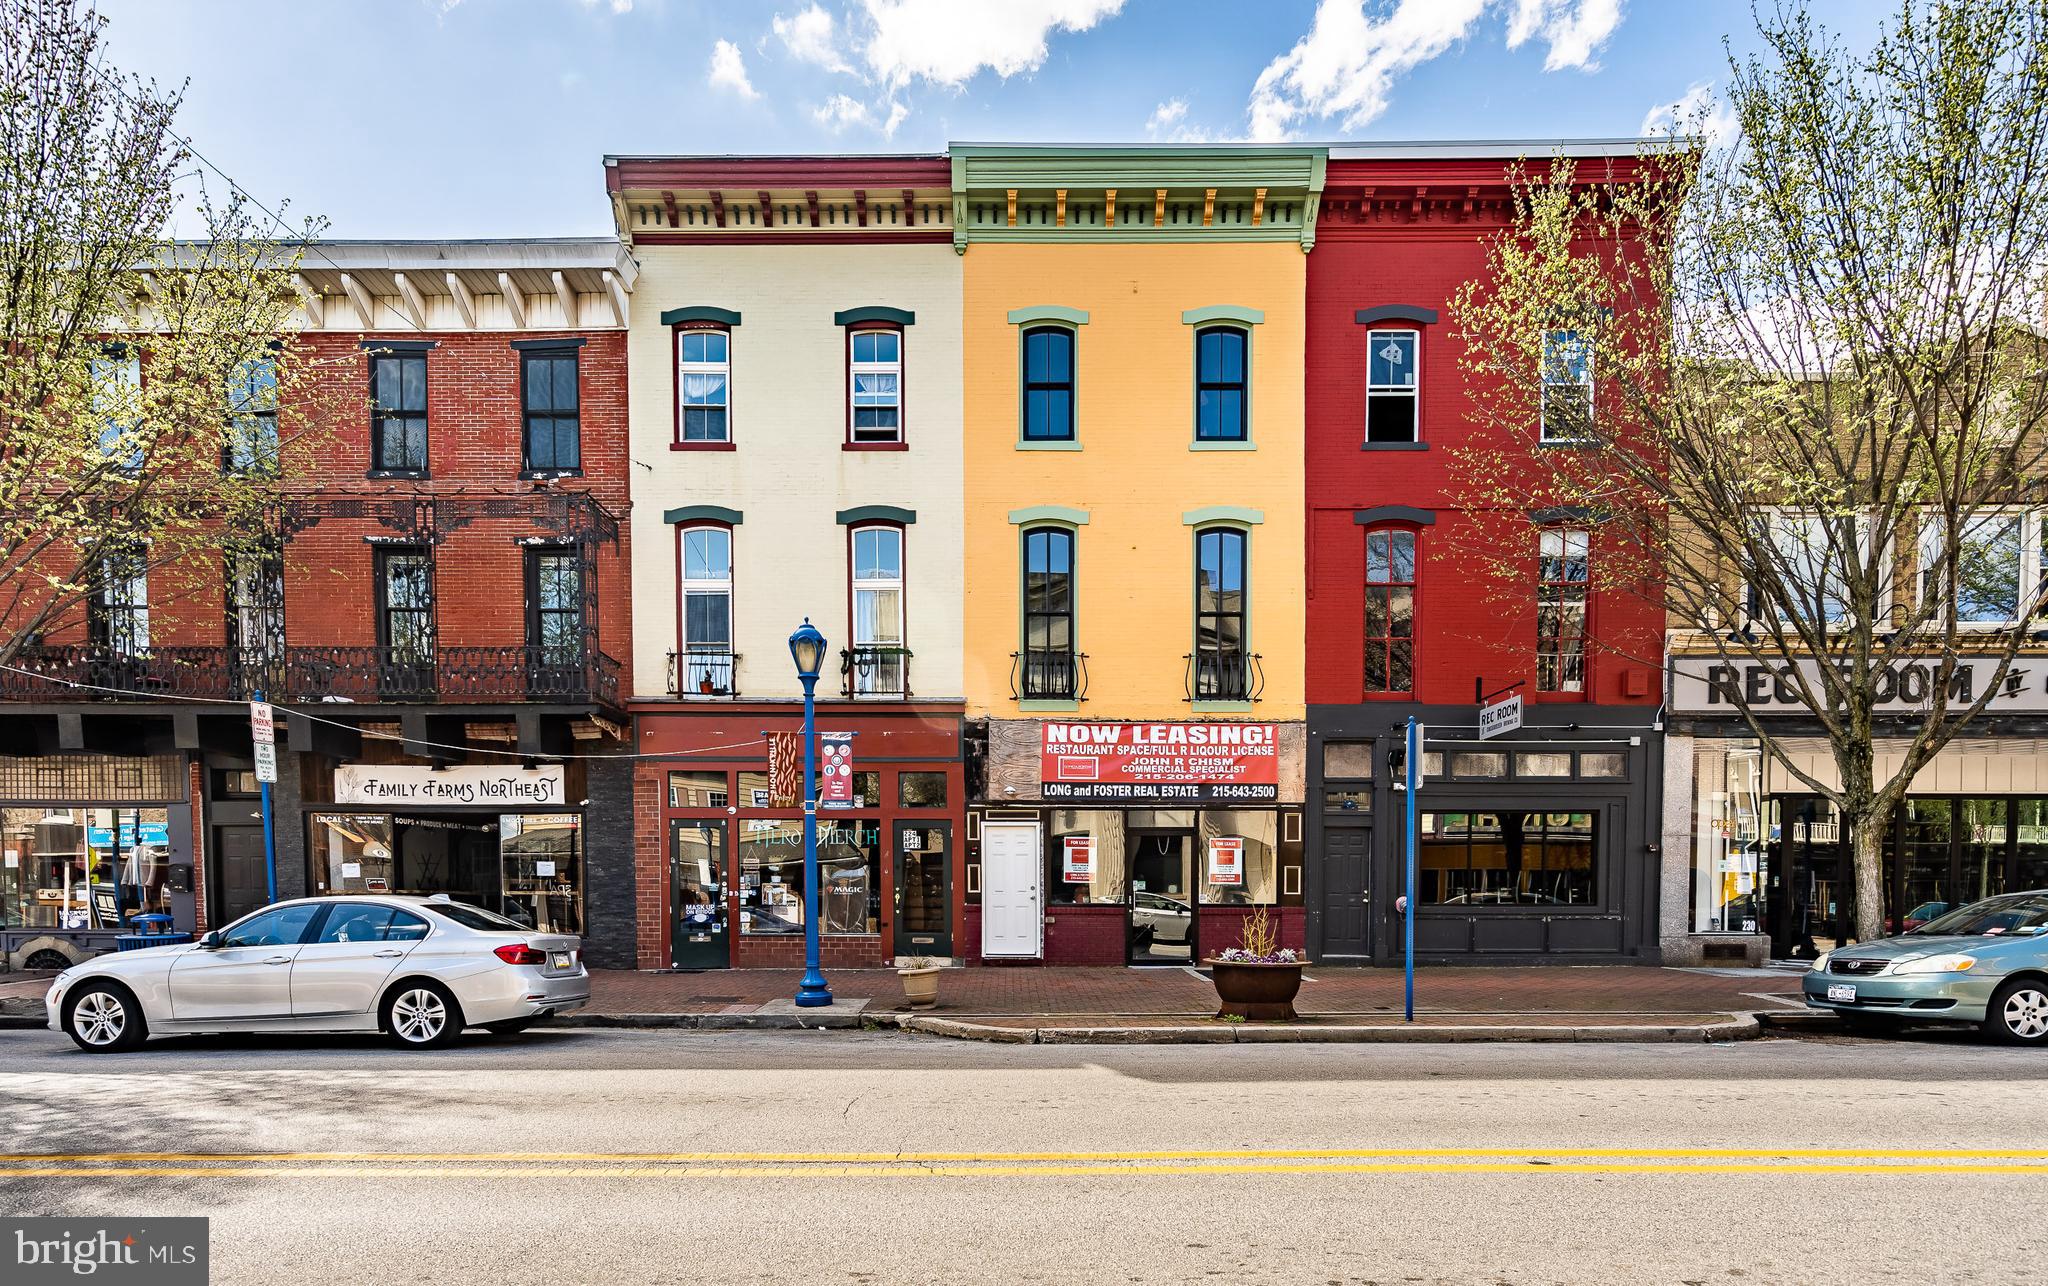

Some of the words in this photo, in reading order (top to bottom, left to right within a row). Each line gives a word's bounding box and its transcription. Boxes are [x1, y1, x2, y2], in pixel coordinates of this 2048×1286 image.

[1708, 665, 1801, 704] REC
[1830, 664, 1974, 704] OOM
[257, 709, 266, 718] NO
[1481, 711, 1495, 726] REC
[1497, 702, 1518, 721] ROOM
[253, 717, 272, 727] PARKING
[1047, 724, 1122, 743] NOW
[1132, 725, 1273, 745] LEASING!
[1046, 744, 1114, 755] RESTAURANT
[1117, 745, 1178, 755] SPACE/FULL
[1180, 746, 1188, 755] R
[1190, 746, 1229, 756] LIQOUR
[1231, 746, 1274, 756] LICENSE
[257, 758, 274, 766] PARKING
[1130, 757, 1170, 765] JOHN
[1188, 758, 1234, 766] CHISM
[1121, 765, 1186, 773] COMMERCIAL
[1189, 766, 1246, 774] SPECIALIST
[363, 779, 418, 797] FAMILY
[422, 780, 475, 803] FARMS
[1044, 784, 1071, 796] LONG
[1073, 785, 1091, 796] and
[1094, 785, 1131, 797] FOSTER
[1133, 785, 1160, 797] REAL
[1161, 785, 1199, 797] ESTATE
[1212, 786, 1275, 798] 215-643-2500
[394, 817, 415, 826] SOUPS
[420, 820, 442, 828] PRODUCE
[547, 816, 578, 824] COFFEE
[756, 827, 802, 848] HERO
[816, 821, 878, 848] MERCH
[1742, 920, 1756, 931] 230
